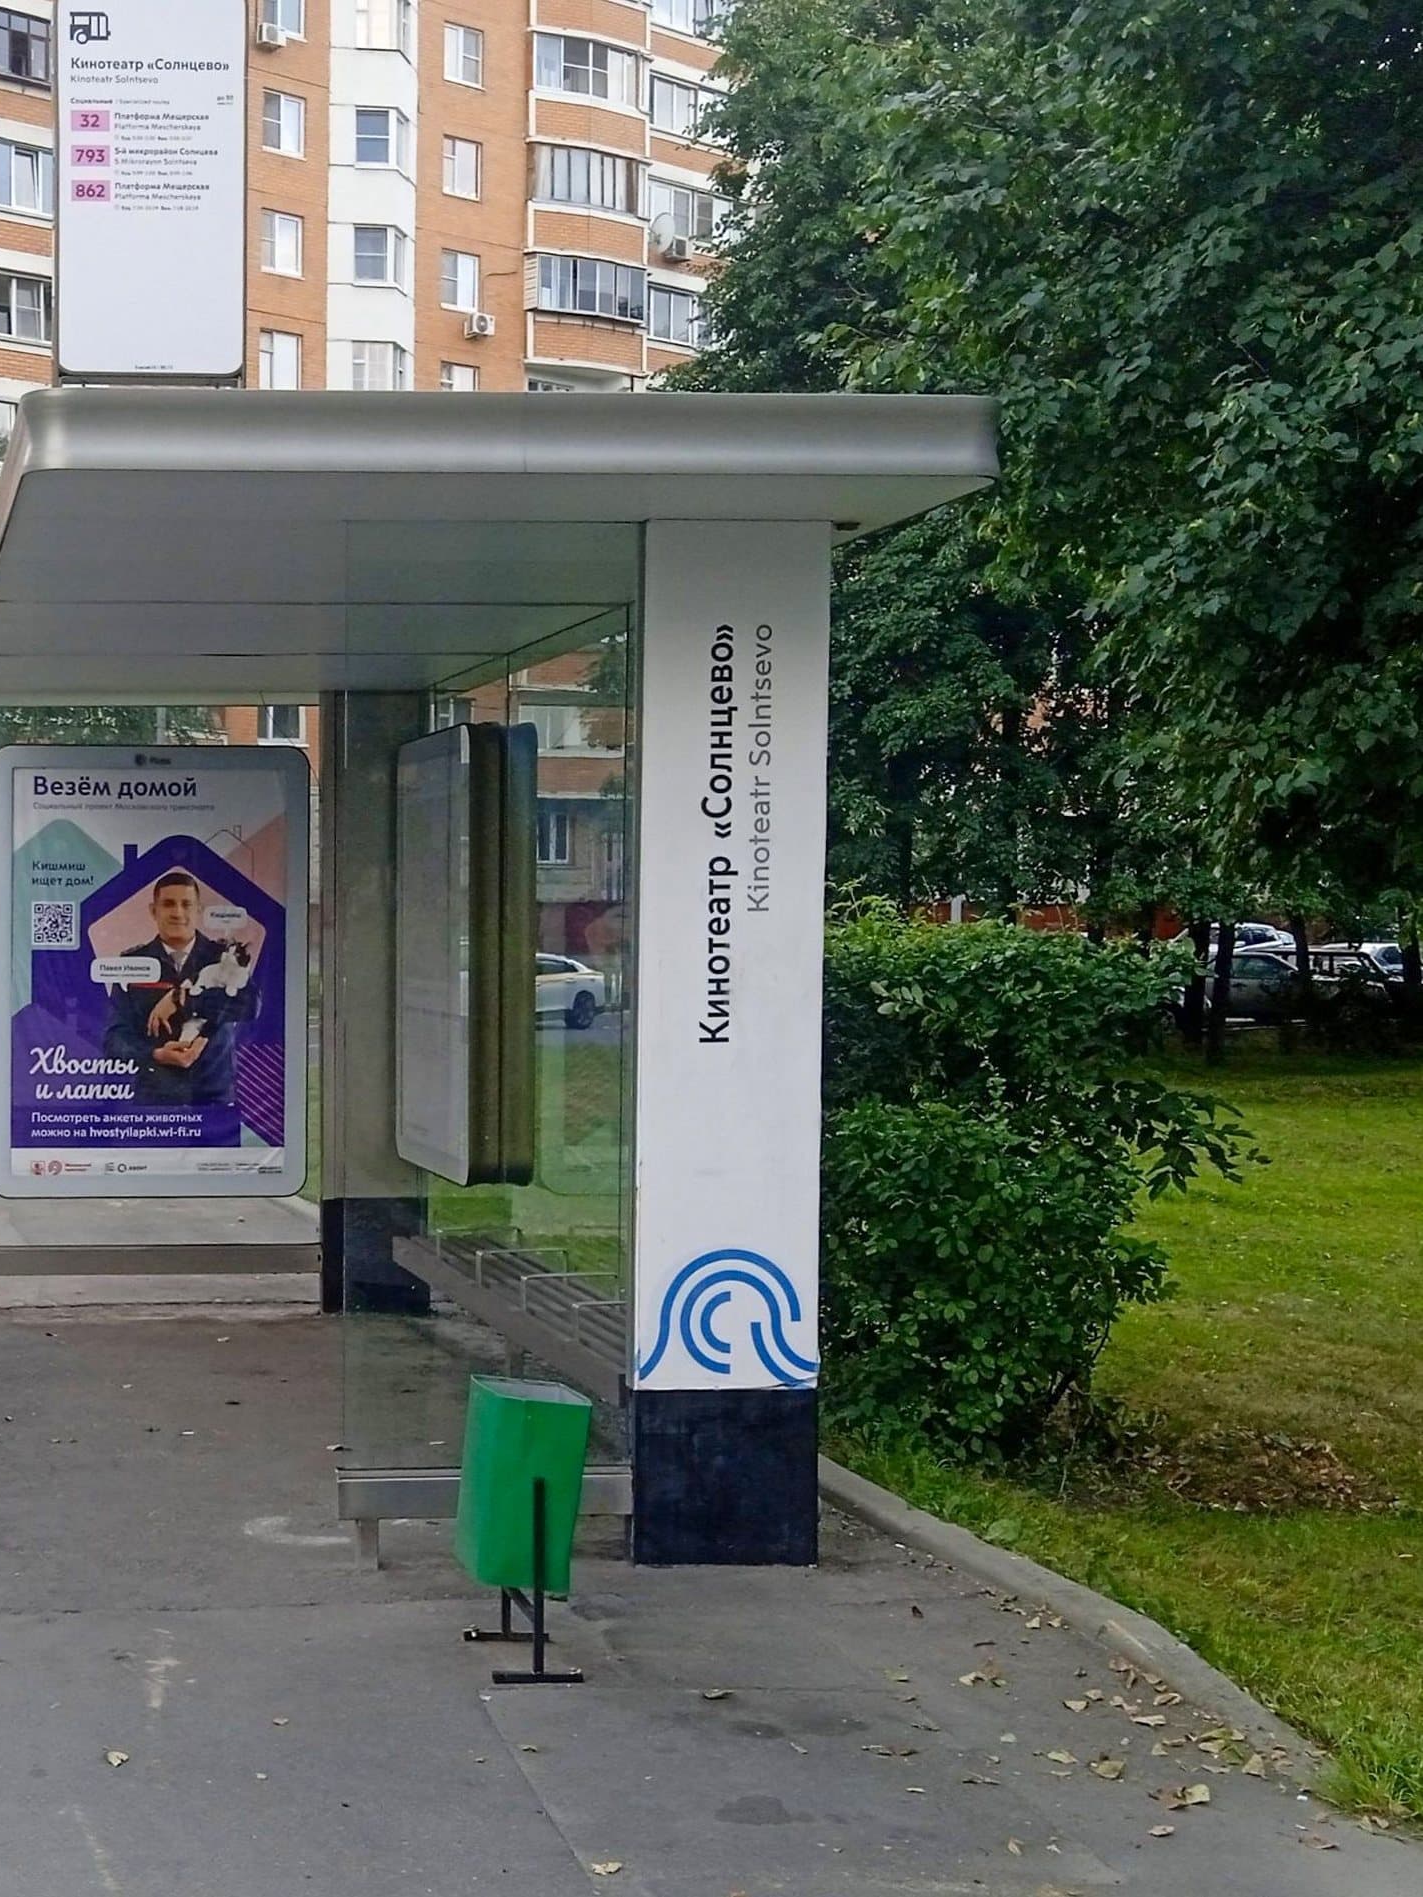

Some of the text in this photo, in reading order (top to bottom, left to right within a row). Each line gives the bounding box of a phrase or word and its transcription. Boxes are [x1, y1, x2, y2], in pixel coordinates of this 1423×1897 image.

[70, 57, 230, 72] Кинотеатр «Солнцево»
[70, 75, 159, 84] Kinoteatr Solntsevo
[80, 114, 100, 128] 32
[114, 112, 210, 121] Платформа Мещерская
[75, 149, 106, 163] 793
[75, 184, 106, 198] 862
[114, 182, 210, 191] Платформа Мещерская
[747, 623, 773, 912] Kinoteatr Solntsevo
[33, 775, 197, 800] Везём домой
[699, 623, 739, 1044] Кинотеатр «Солнцево»
[32, 860, 86, 871] Кишмиш
[32, 875, 94, 887] ищет дом!
[29, 1044, 139, 1075] Хвосты
[35, 1083, 135, 1100] и лапки
[31, 1111, 203, 1125] Посмотреть анкеты животных
[31, 1128, 72, 1138] можно
[73, 1129, 88, 1138] на
